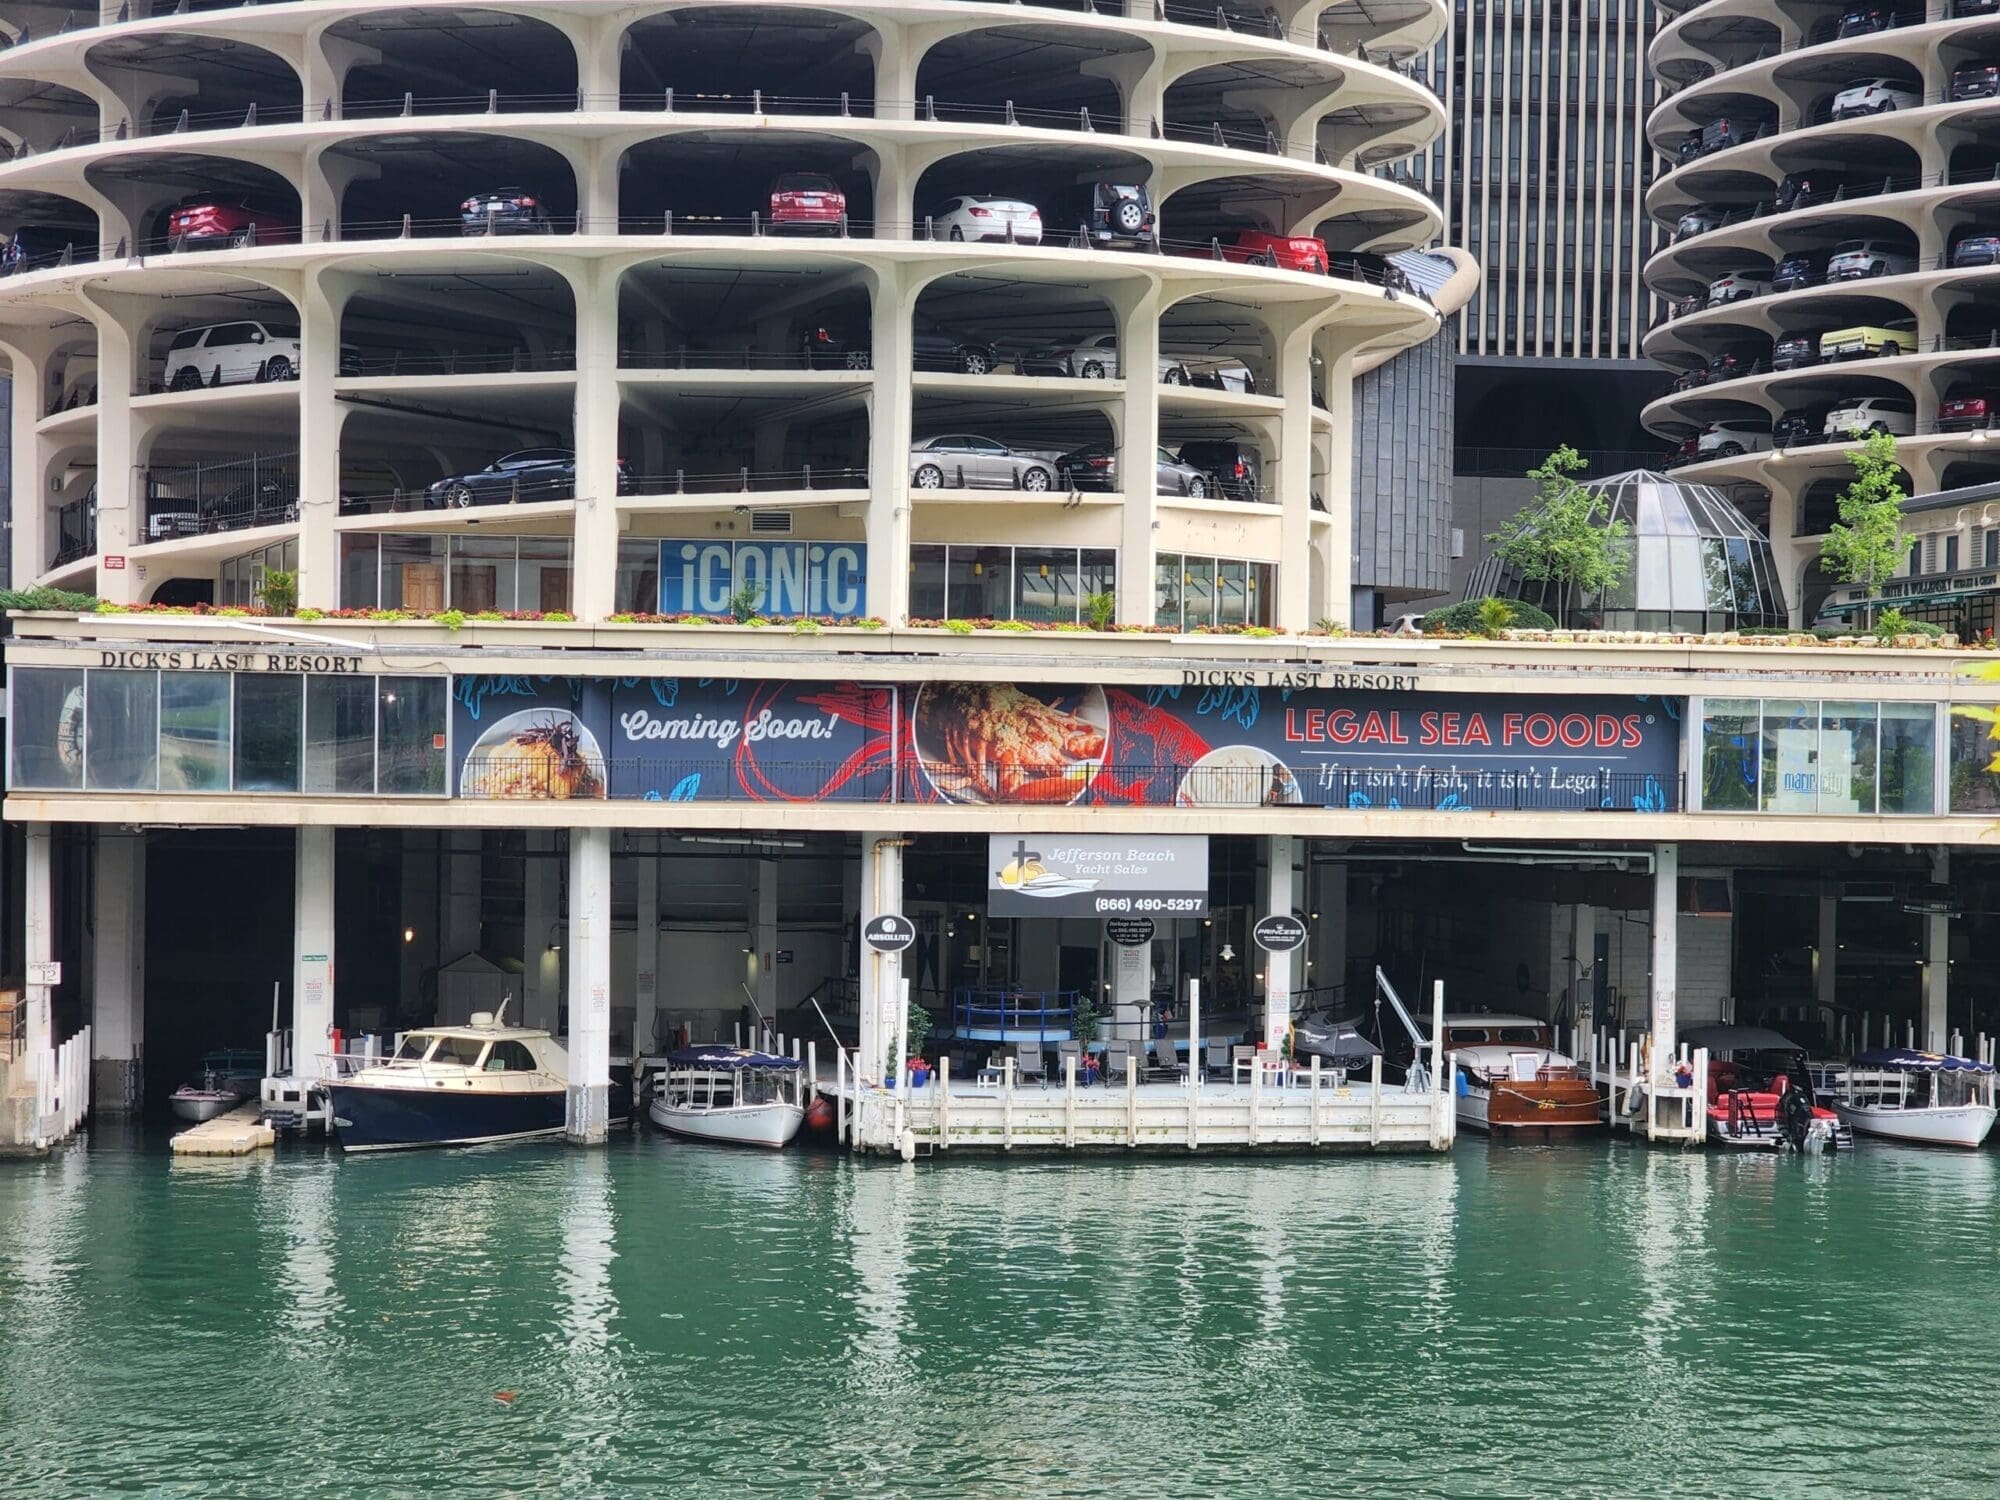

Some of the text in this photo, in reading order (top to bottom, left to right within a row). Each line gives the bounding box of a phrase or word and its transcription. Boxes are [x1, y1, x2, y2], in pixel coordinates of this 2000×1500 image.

[100, 651, 363, 673] DICK'S LAST RESORT
[1182, 670, 1420, 691] DICK'S LAST RESORT
[621, 709, 840, 749] Coming Soon!
[1285, 708, 1409, 744] LEGAL
[1420, 711, 1492, 746] SEA
[1318, 762, 1340, 790] If
[1342, 767, 1359, 786] it
[1366, 764, 1408, 787] isn't
[1413, 765, 1468, 793] fresh,
[1477, 768, 1493, 789] it
[1500, 766, 1543, 789] isn't
[1047, 848, 1175, 864] Jefferson Beach
[1075, 864, 1149, 874] Yacht Sales
[1095, 897, 1203, 912] (866) 490-5297
[867, 933, 911, 942] ABSOLUTE
[42, 970, 56, 981] 12
